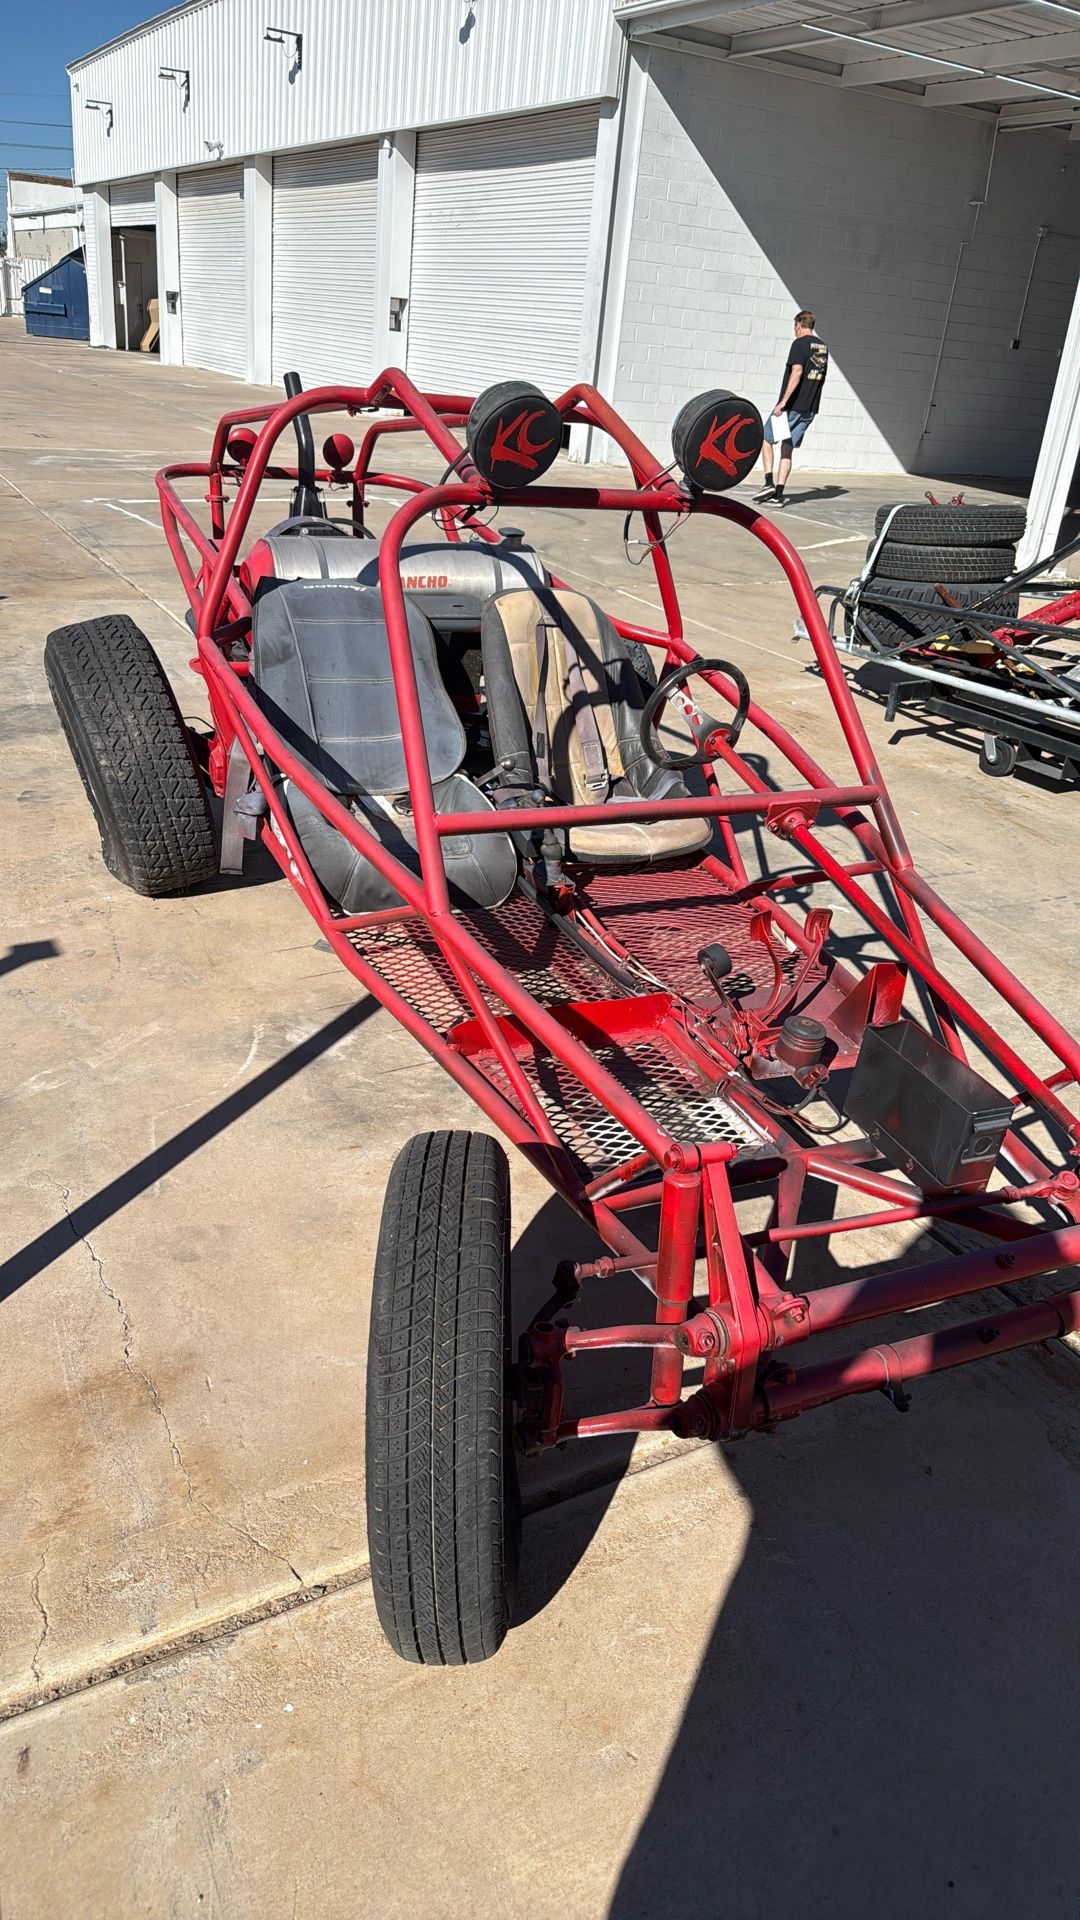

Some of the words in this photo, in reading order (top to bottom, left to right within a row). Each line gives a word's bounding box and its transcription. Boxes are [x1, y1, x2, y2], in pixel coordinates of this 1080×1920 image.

[490, 410, 555, 472] KC
[695, 414, 757, 477] KC
[401, 575, 448, 589] NCHO
